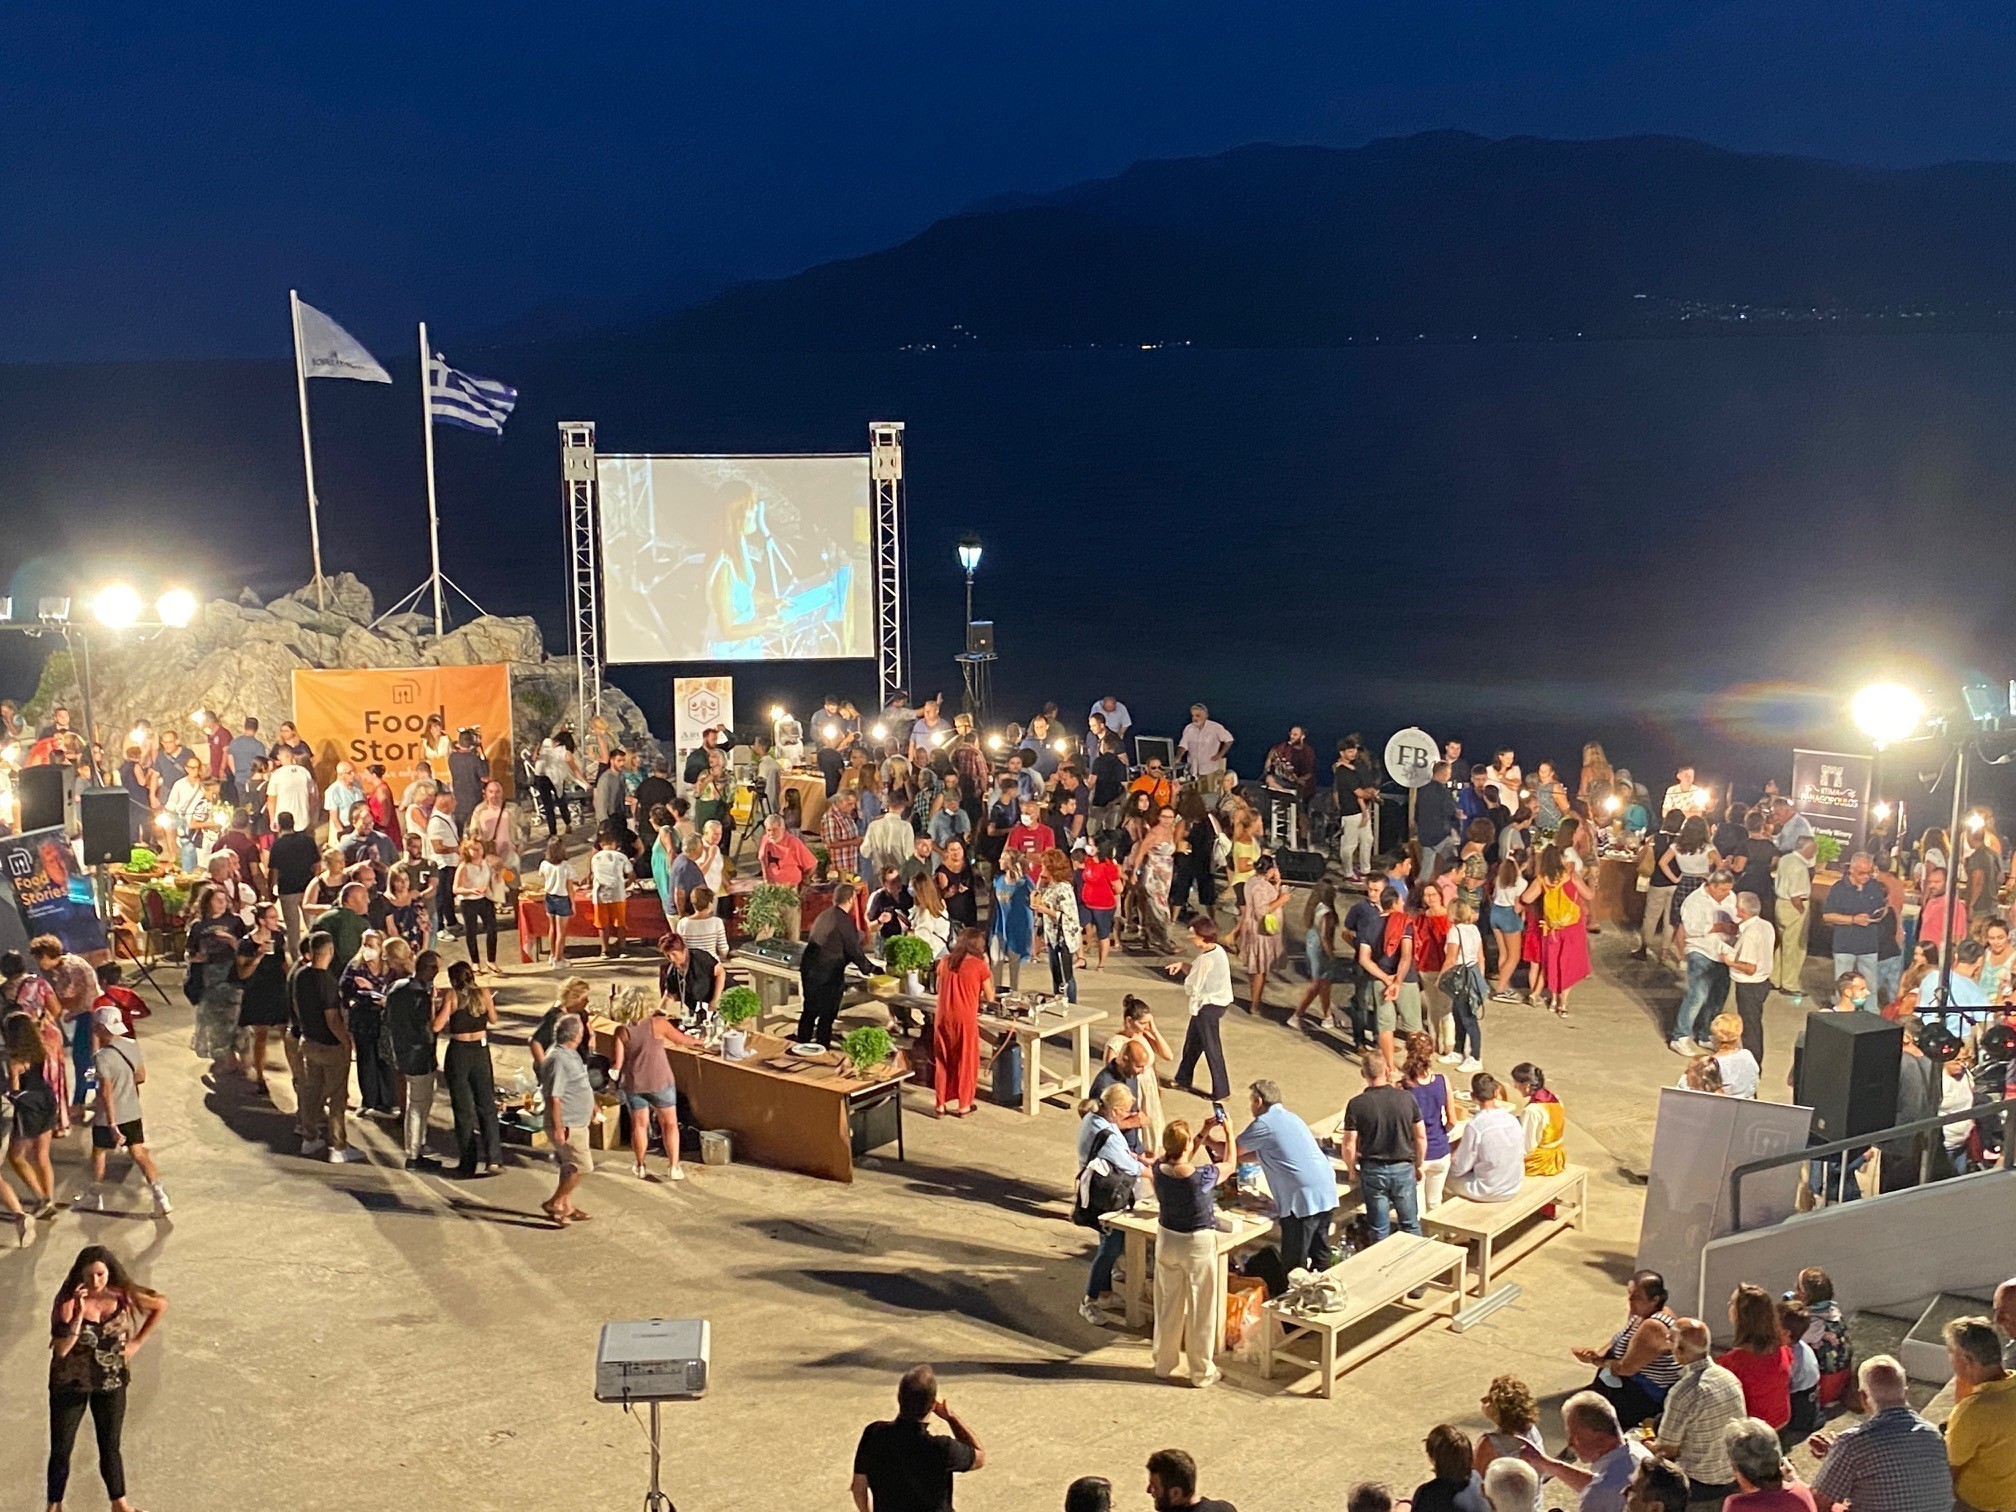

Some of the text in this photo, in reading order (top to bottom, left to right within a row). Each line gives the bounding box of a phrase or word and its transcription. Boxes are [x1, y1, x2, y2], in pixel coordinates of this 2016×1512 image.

[350, 739, 419, 763] Stor
[1397, 744, 1428, 769] FB
[14, 869, 51, 891] Food
[20, 885, 68, 906] Stories
